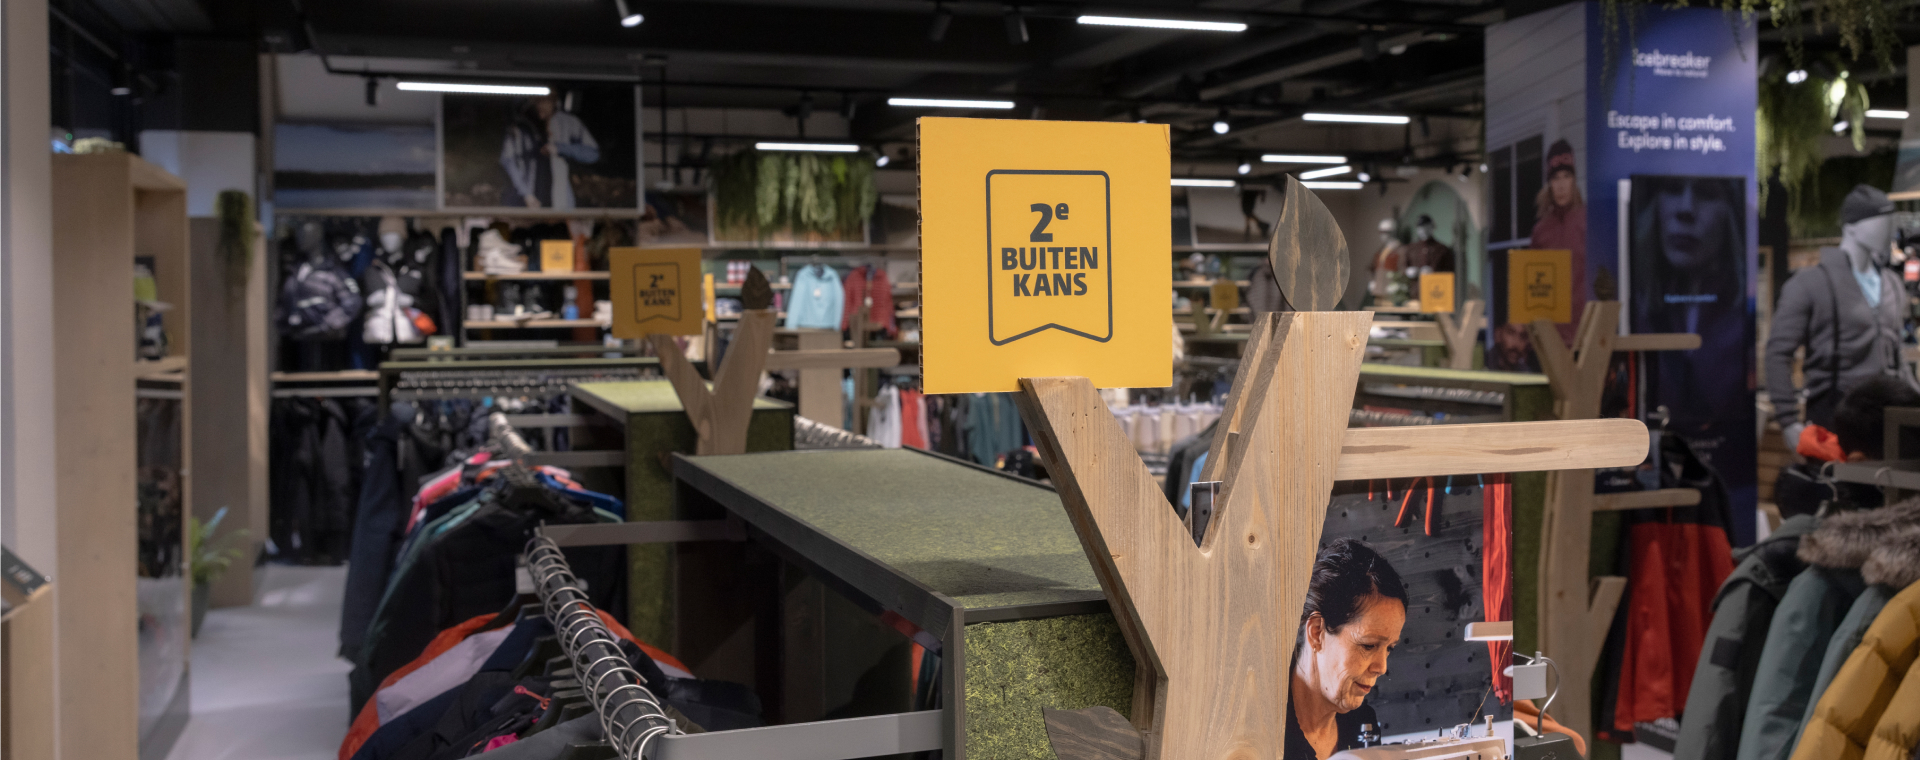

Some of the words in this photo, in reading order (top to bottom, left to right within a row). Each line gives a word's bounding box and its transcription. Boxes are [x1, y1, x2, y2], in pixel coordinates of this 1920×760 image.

[1607, 110, 1660, 133] Escape
[1661, 112, 1676, 130] in
[1677, 114, 1736, 132] comfort.
[1617, 130, 1672, 153] Explore
[1673, 132, 1688, 150] in
[1690, 133, 1726, 155] style.
[1001, 246, 1098, 270] BUITEN
[1013, 273, 1088, 297] KANS
